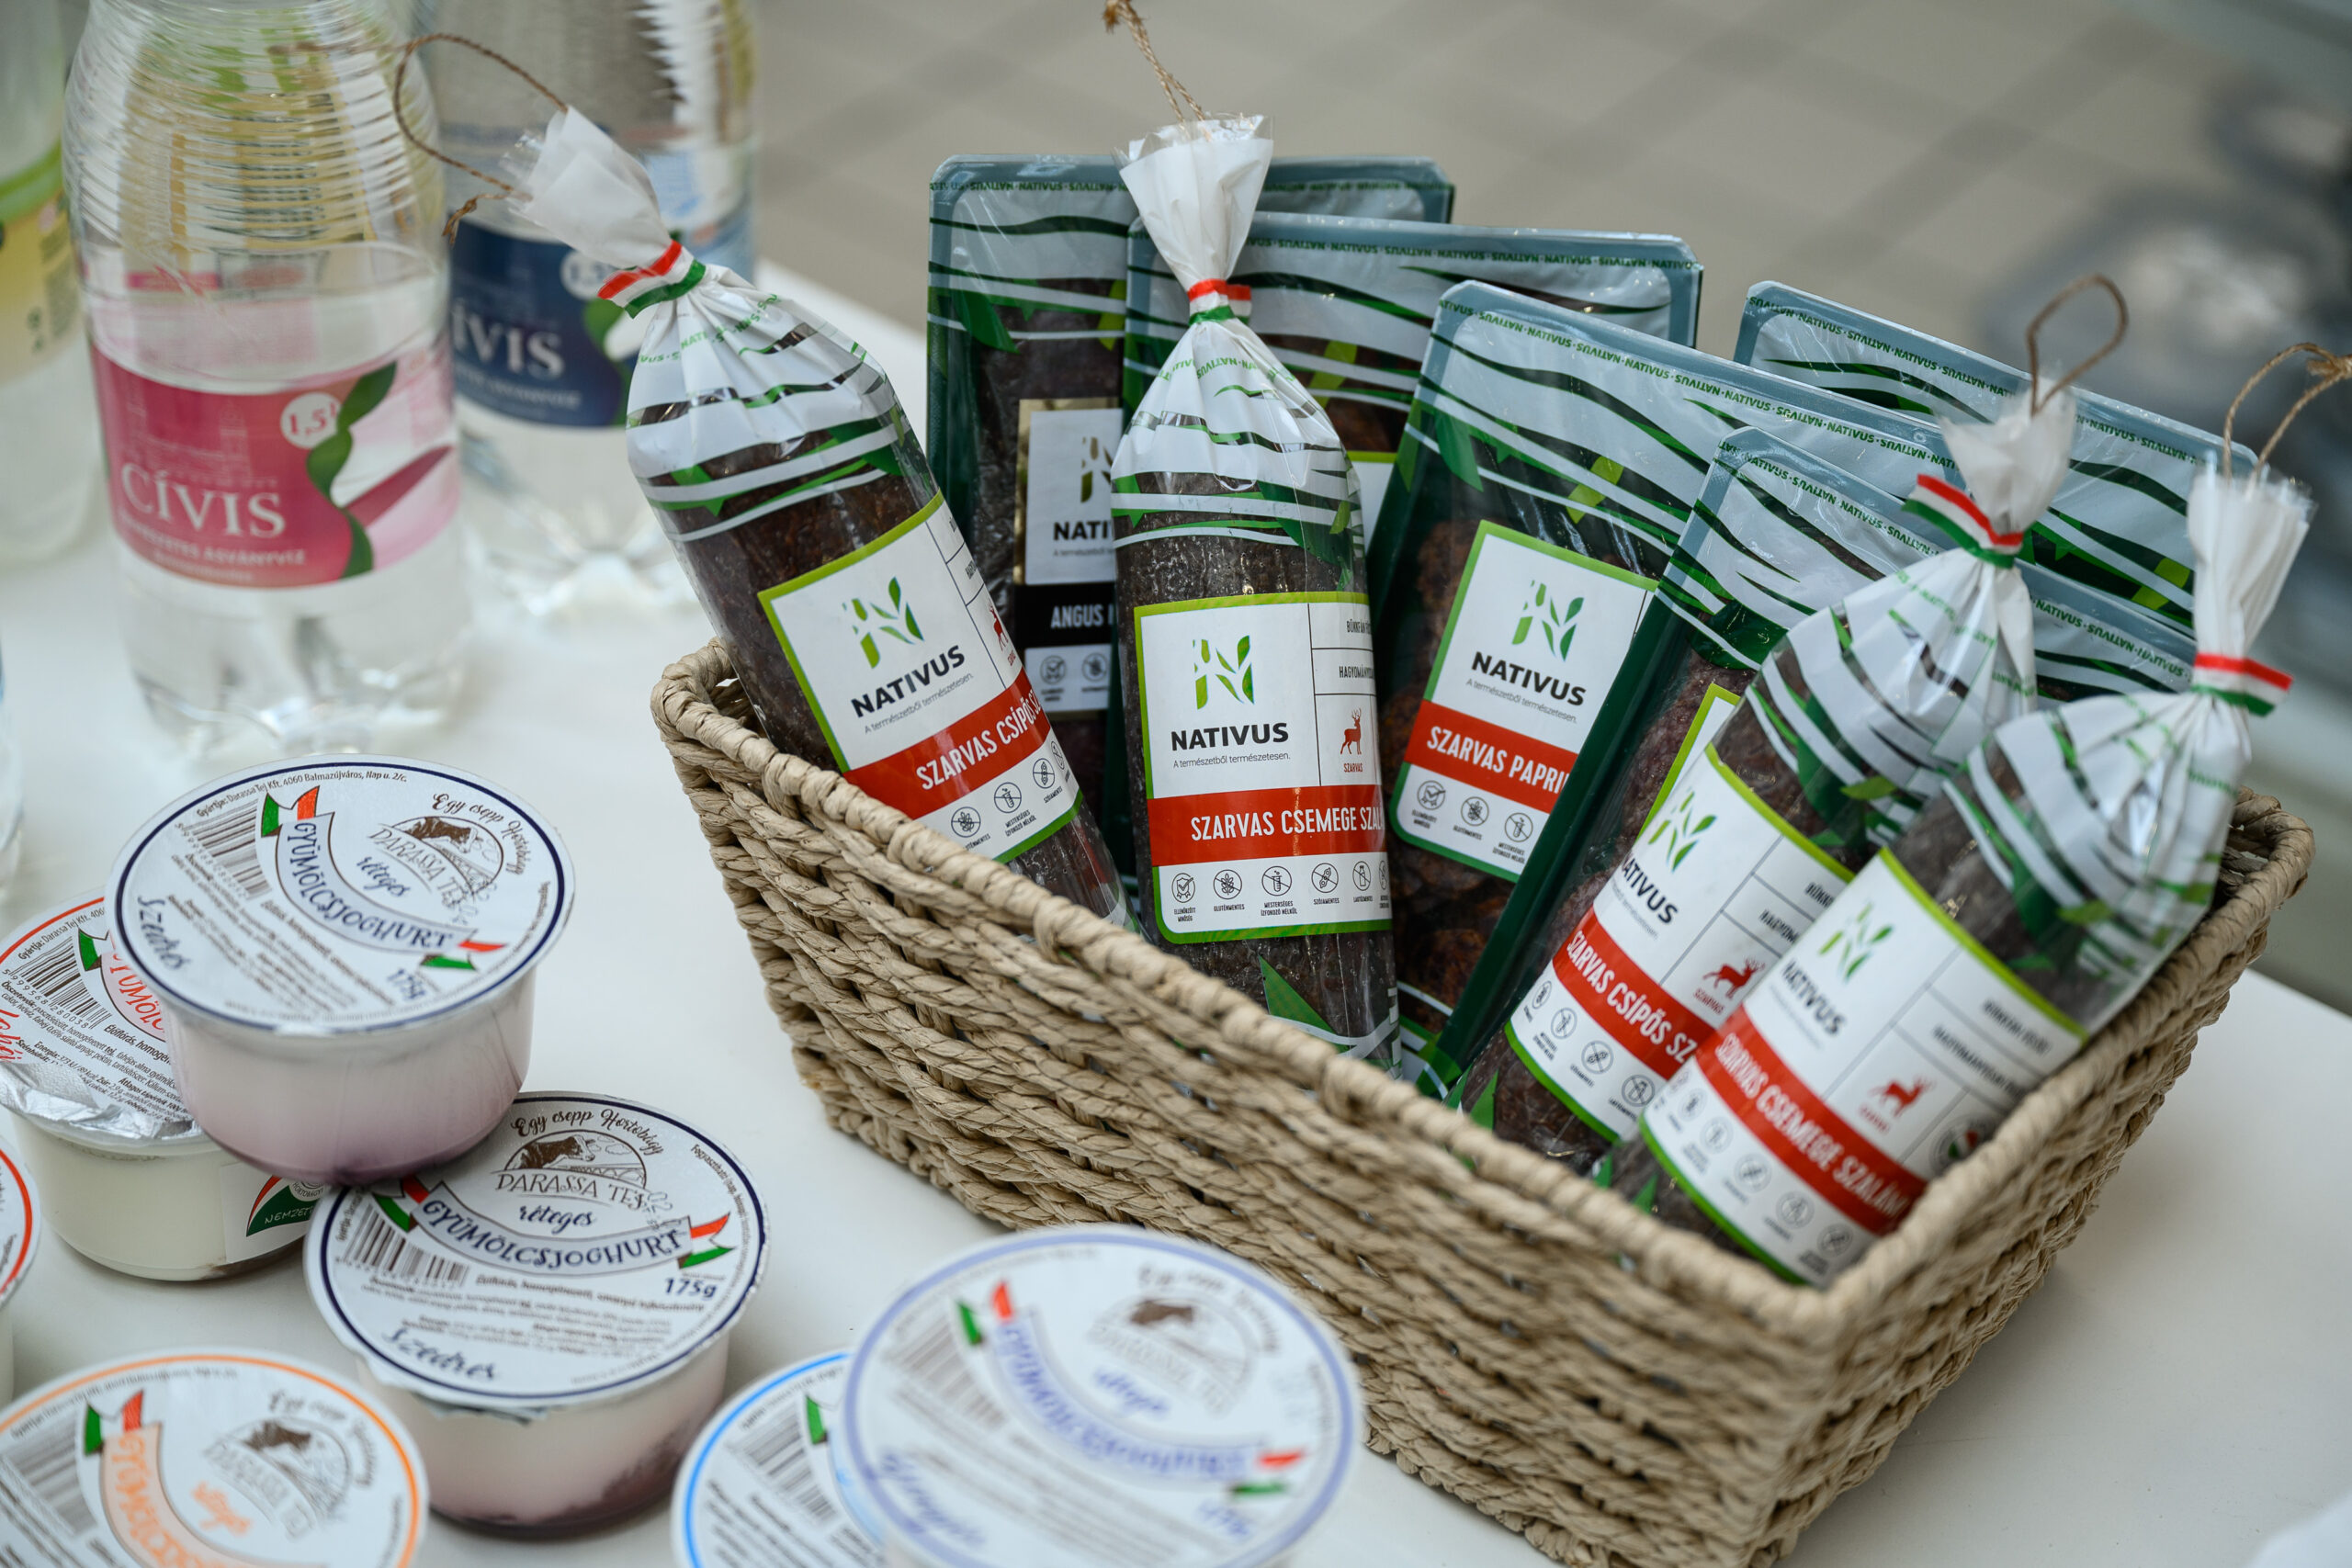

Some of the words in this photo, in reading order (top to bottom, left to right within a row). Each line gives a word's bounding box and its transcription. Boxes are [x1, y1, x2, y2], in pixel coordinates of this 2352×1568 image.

[121, 462, 286, 539] CÍVIS
[1053, 520, 1109, 541] NATI
[1050, 604, 1103, 629] ANGUS
[851, 645, 965, 718] NATIVUS
[1472, 651, 1587, 706] NATIVUS
[1170, 722, 1289, 751] NATIVUS
[1427, 726, 1508, 773] SZARVAS
[283, 775, 303, 787] 4060
[304, 770, 365, 783] Balmazújváros,
[365, 771, 382, 781] Nap
[916, 730, 999, 790] SZARVAS
[1173, 760, 1179, 768] A
[1180, 755, 1227, 768] természetből
[1229, 752, 1291, 764] természetesen.
[1343, 762, 1363, 773] SZARVAS
[432, 793, 466, 815] Egy
[469, 803, 504, 824] csepp
[1191, 810, 1274, 841] SZARVAS
[1281, 805, 1358, 837] CSEMEGE
[367, 825, 448, 884] DARASSA
[287, 821, 455, 950] GYÜMÖLCSJOGHURT
[18, 936, 46, 961] Gyártja:
[42, 924, 68, 943] Darassa
[65, 919, 77, 933] Tej
[76, 914, 91, 927] Kft.
[1566, 930, 1615, 994] SZARVAS
[1607, 982, 1672, 1045] CSÍPŐS
[104, 1024, 136, 1046] Élőflórás,
[511, 1115, 548, 1137] Egy
[552, 1110, 594, 1127] csepp
[600, 1108, 663, 1156] Hortobágy
[493, 1172, 598, 1199] DARASSA
[608, 1183, 645, 1212] TEJ
[422, 1199, 683, 1269] GYÜMÖLCSJOGHURT
[519, 1204, 594, 1235] réteges
[664, 1277, 718, 1302] 175g
